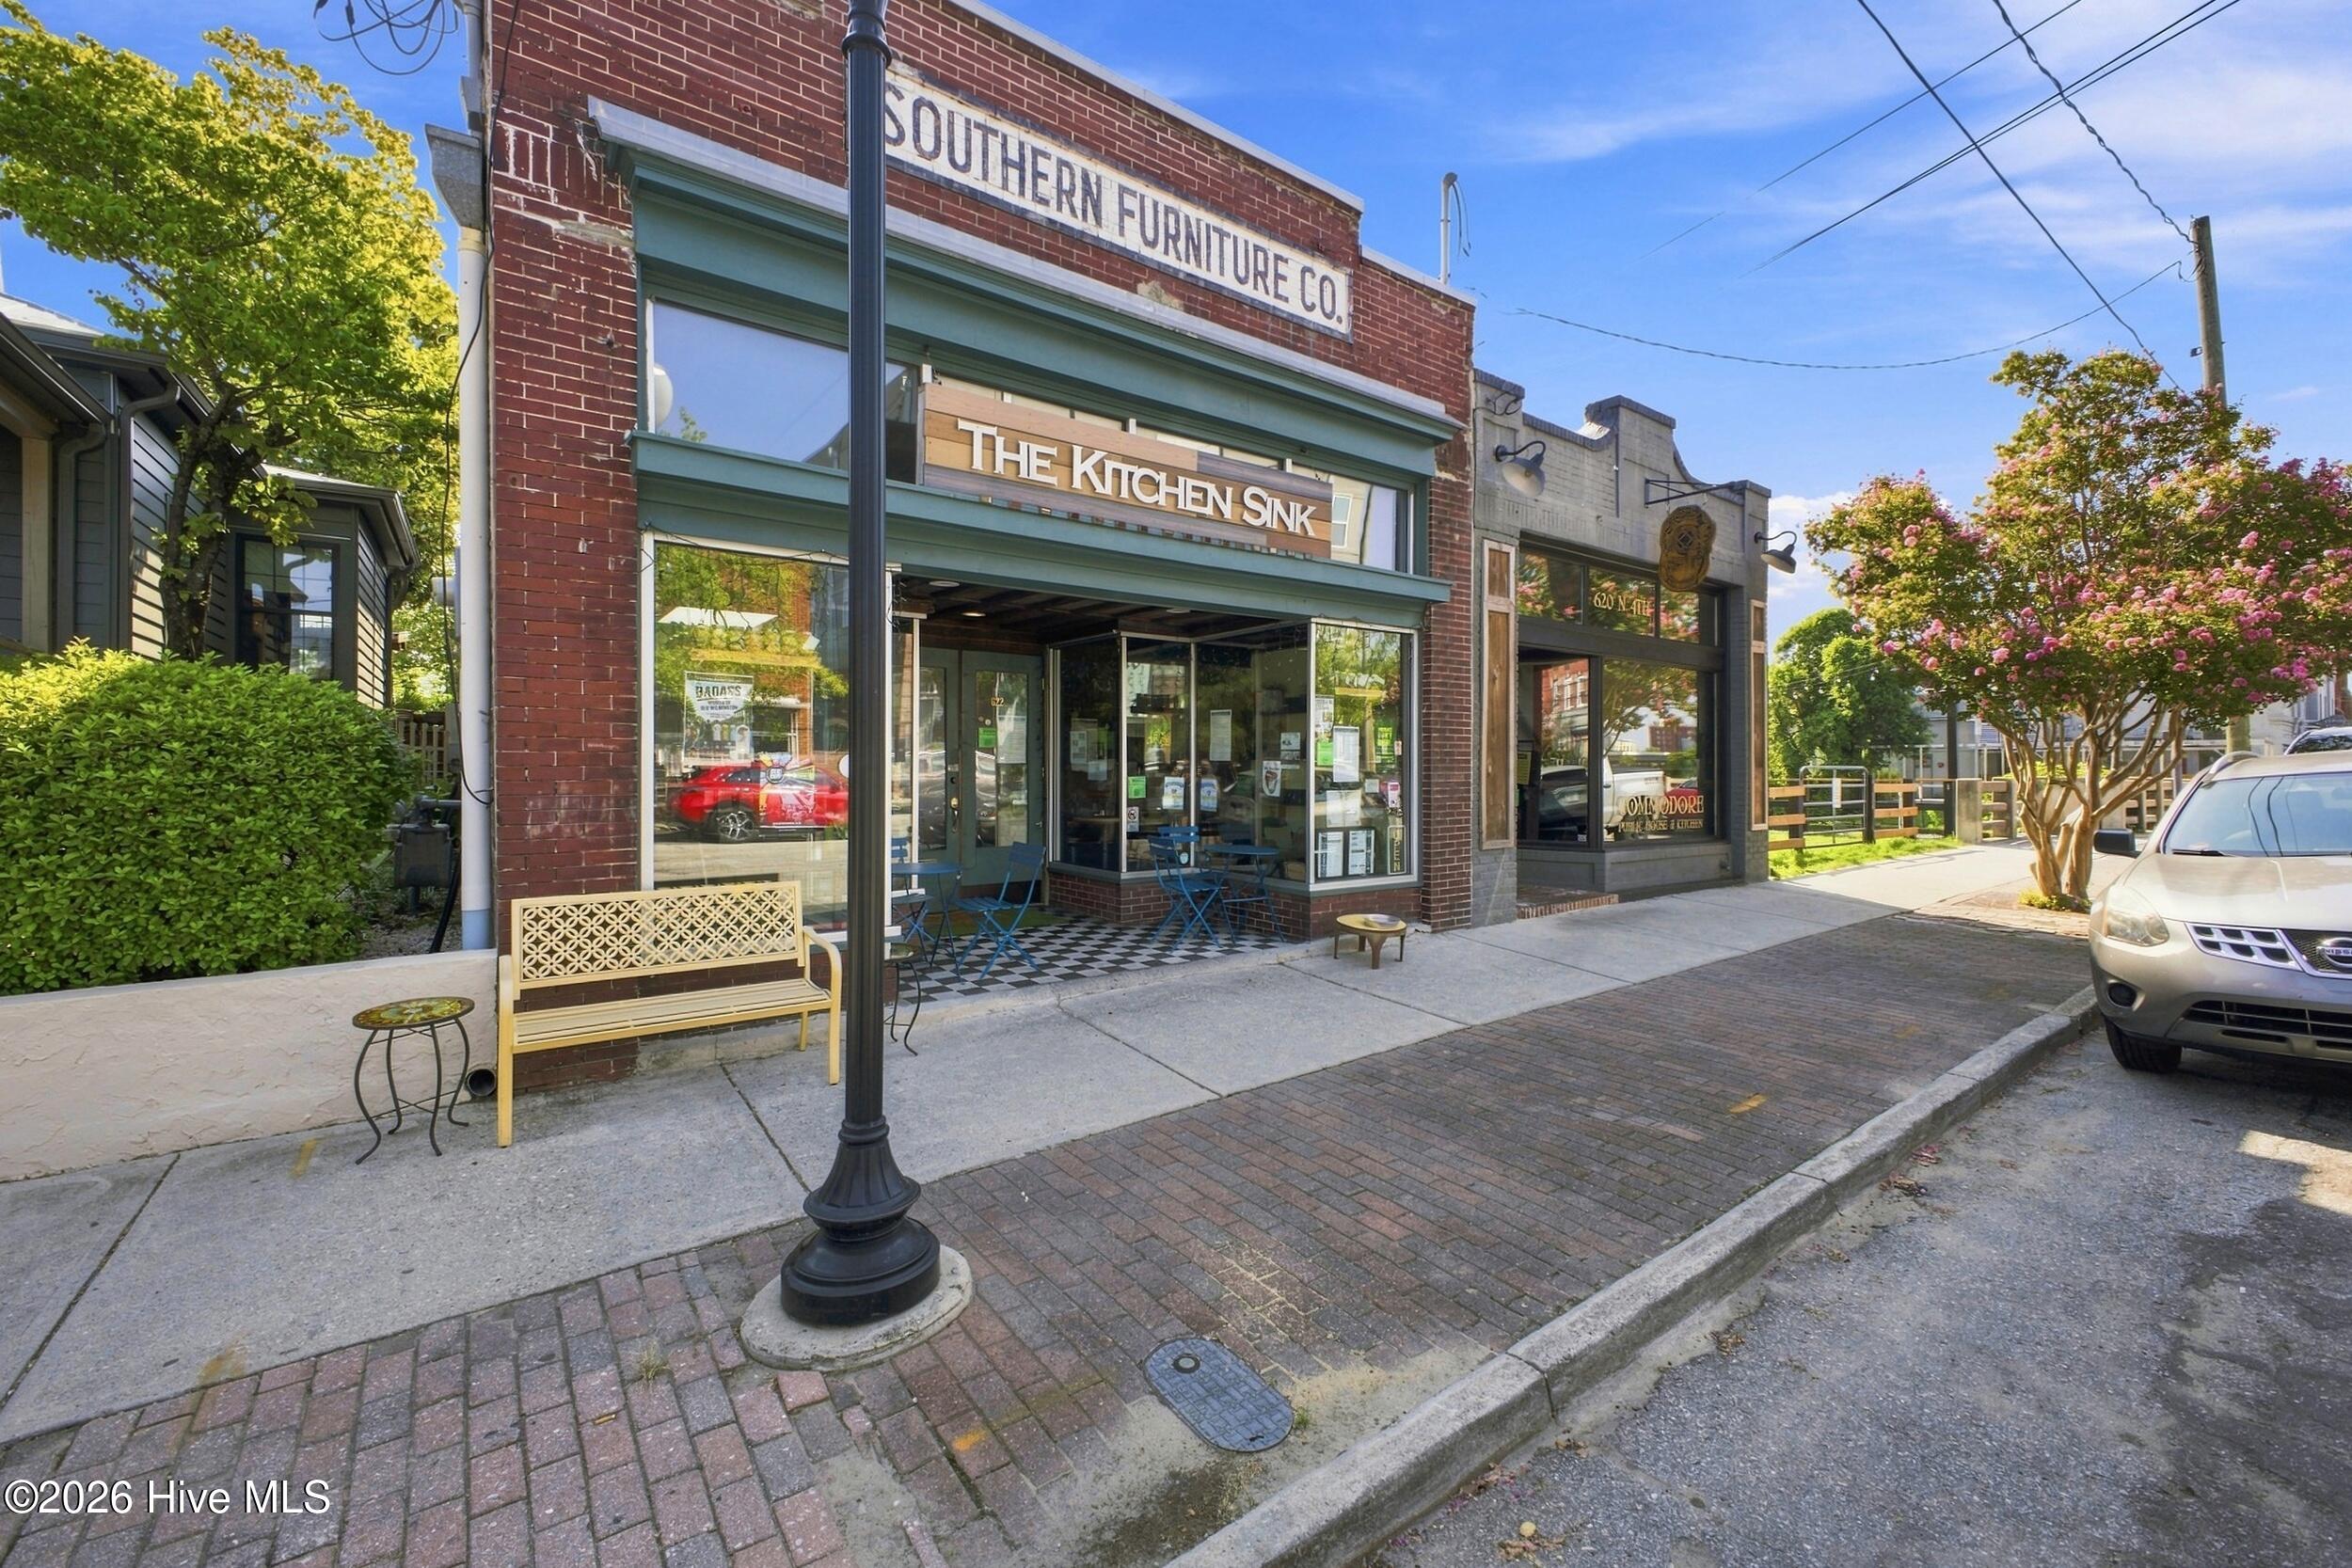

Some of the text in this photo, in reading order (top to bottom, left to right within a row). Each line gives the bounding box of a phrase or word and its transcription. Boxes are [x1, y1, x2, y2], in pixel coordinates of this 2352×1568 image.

[884, 81, 1343, 325] SOUTHERN FURNITURE CO.
[957, 418, 1317, 536] THE KITCHEN SINK
[1594, 592, 1614, 610] 620
[1617, 594, 1627, 611] N
[695, 685, 741, 698] BADASS
[990, 696, 1005, 707] 622
